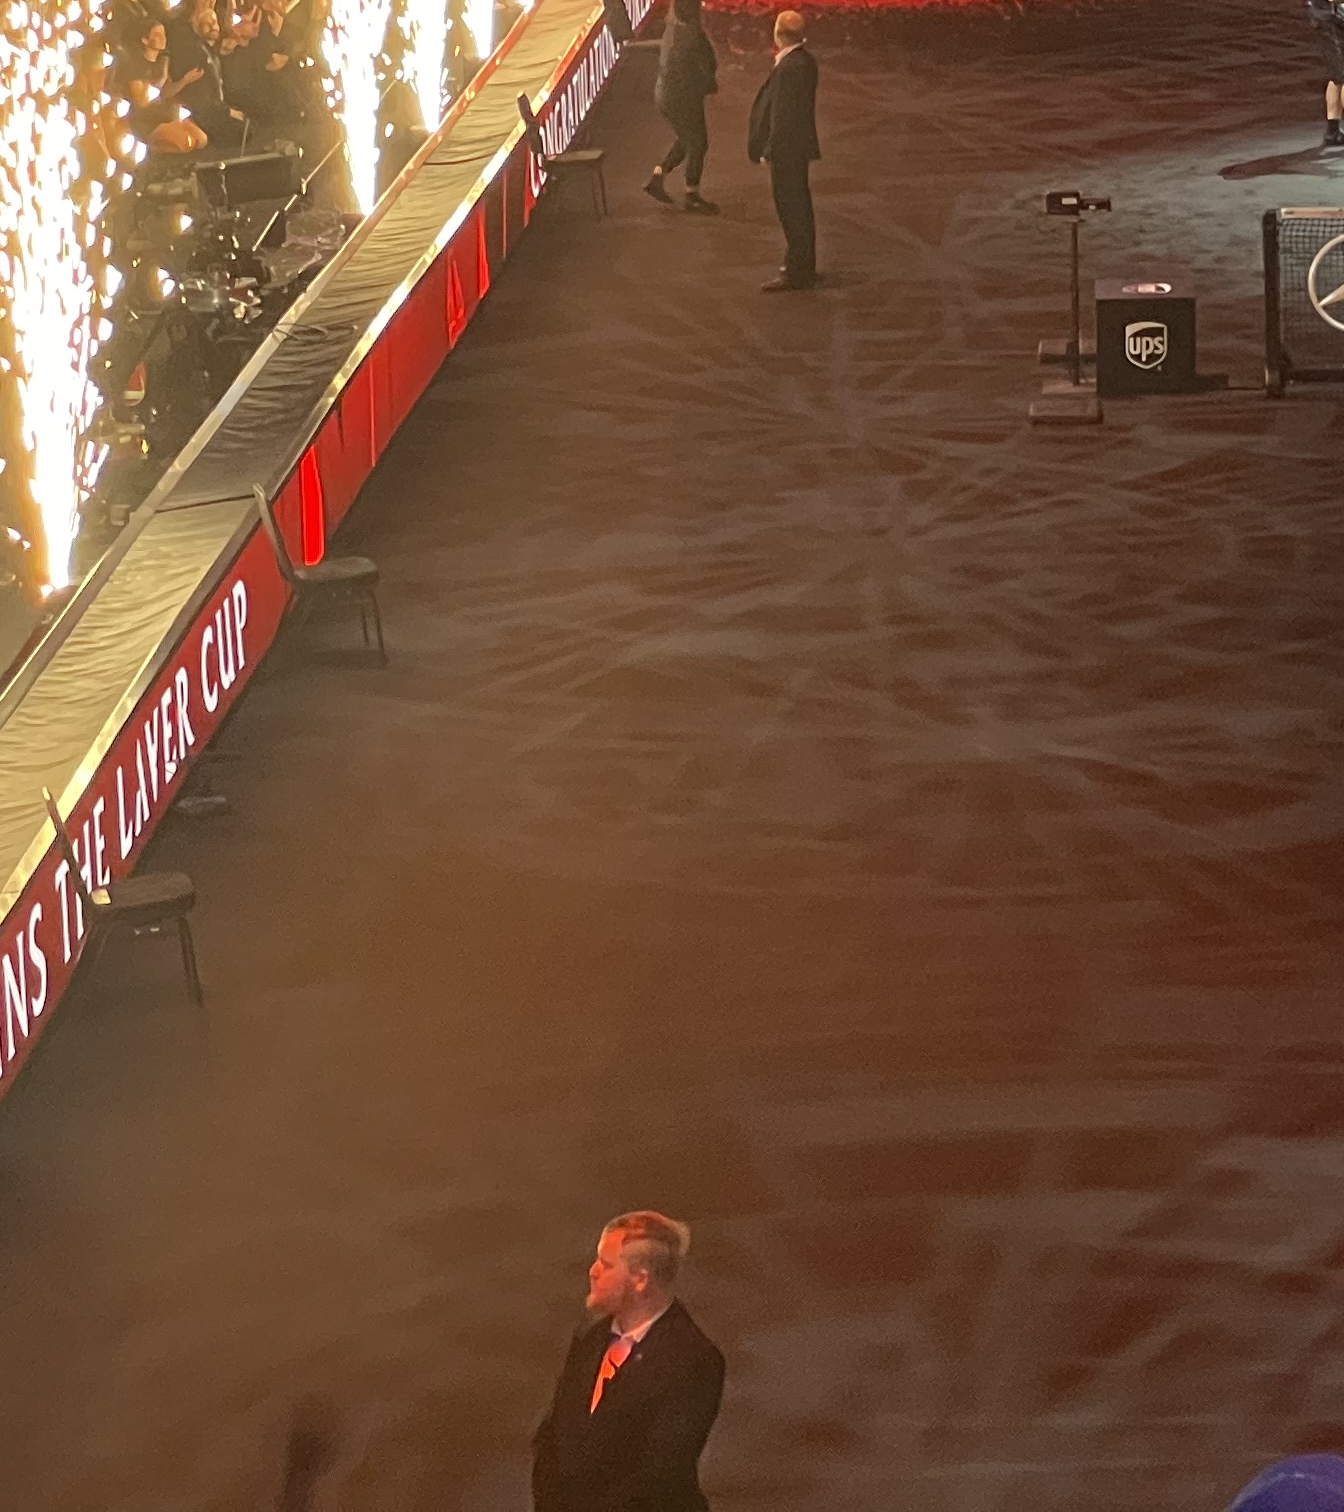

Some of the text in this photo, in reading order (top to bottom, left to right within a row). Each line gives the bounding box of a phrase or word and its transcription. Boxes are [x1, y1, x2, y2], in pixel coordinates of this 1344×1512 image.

[54, 796, 112, 964] THE
[117, 665, 196, 859] LAVER
[200, 578, 249, 714] CUP
